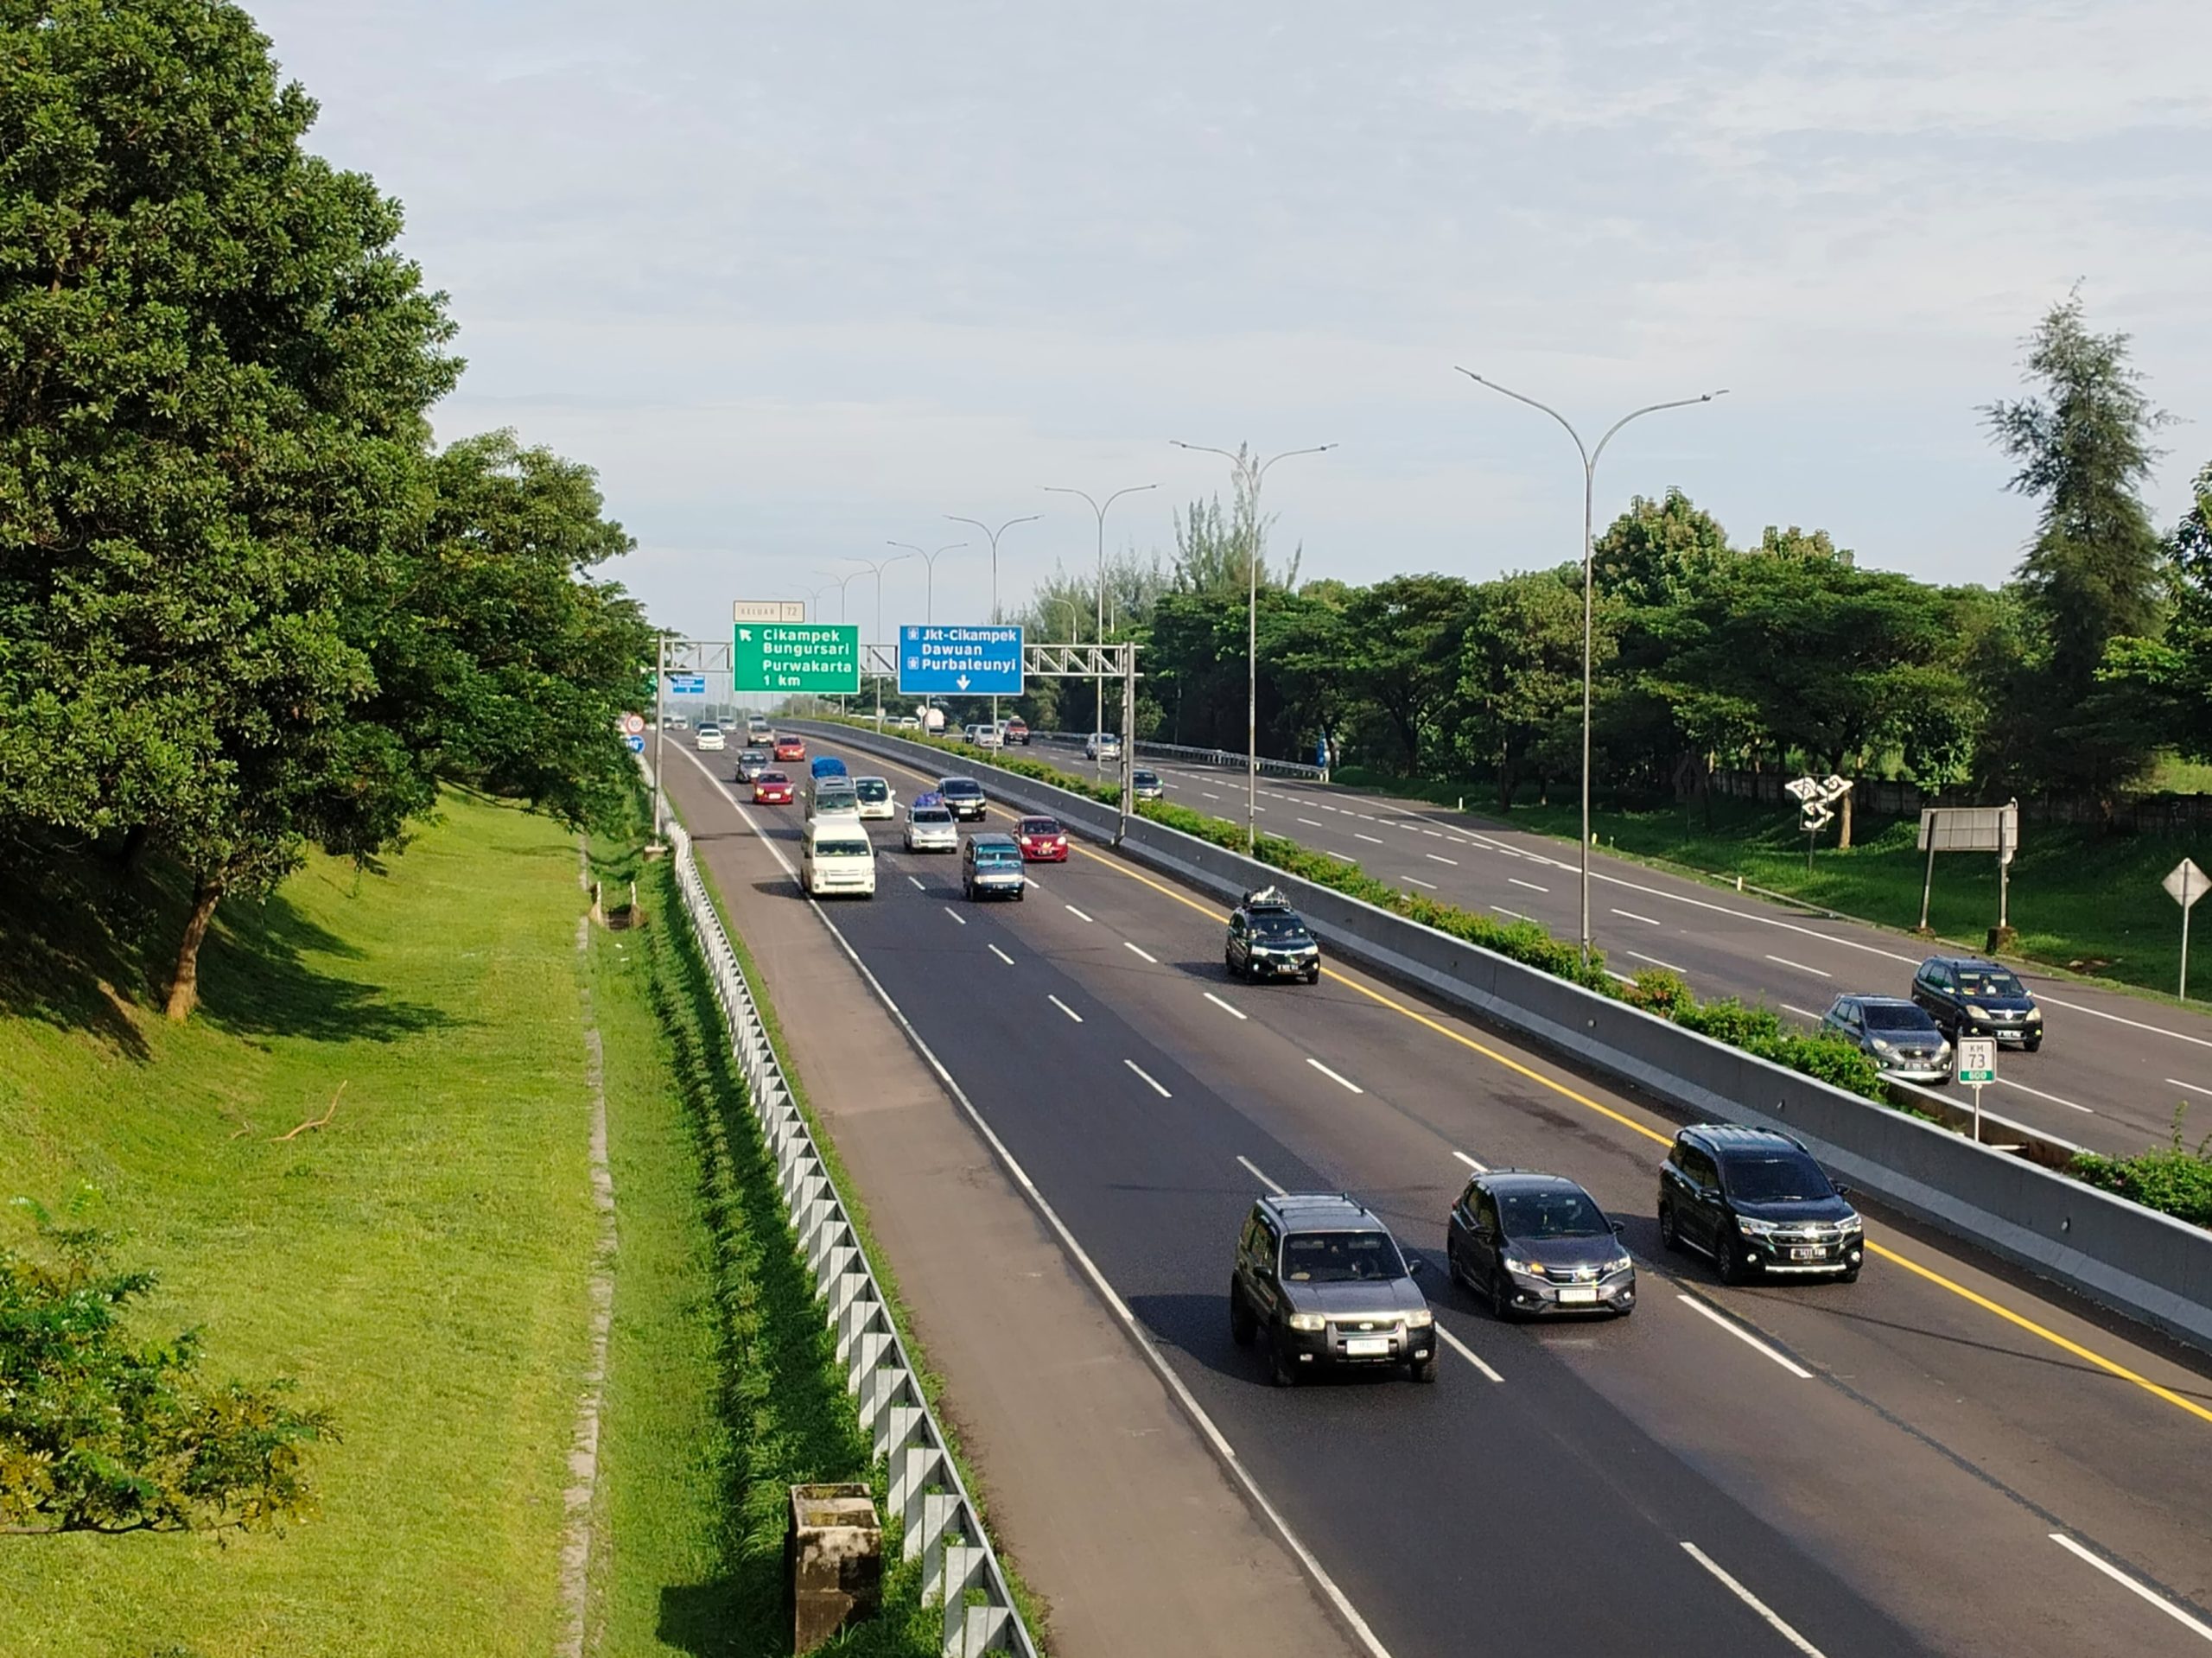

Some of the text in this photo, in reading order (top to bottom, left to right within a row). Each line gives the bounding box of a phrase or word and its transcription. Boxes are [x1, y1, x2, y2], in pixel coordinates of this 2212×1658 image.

[787, 607, 798, 616] 72
[763, 629, 840, 645] Cikampek
[923, 629, 1017, 645] Jkt-Cikampek
[763, 642, 849, 657] Bungursari
[922, 644, 982, 656] Dawuan
[762, 659, 852, 673] Purwakarta
[922, 658, 1016, 674] Purbaleunyi
[763, 674, 801, 686] 1 km
[1969, 1054, 1986, 1068] 73
